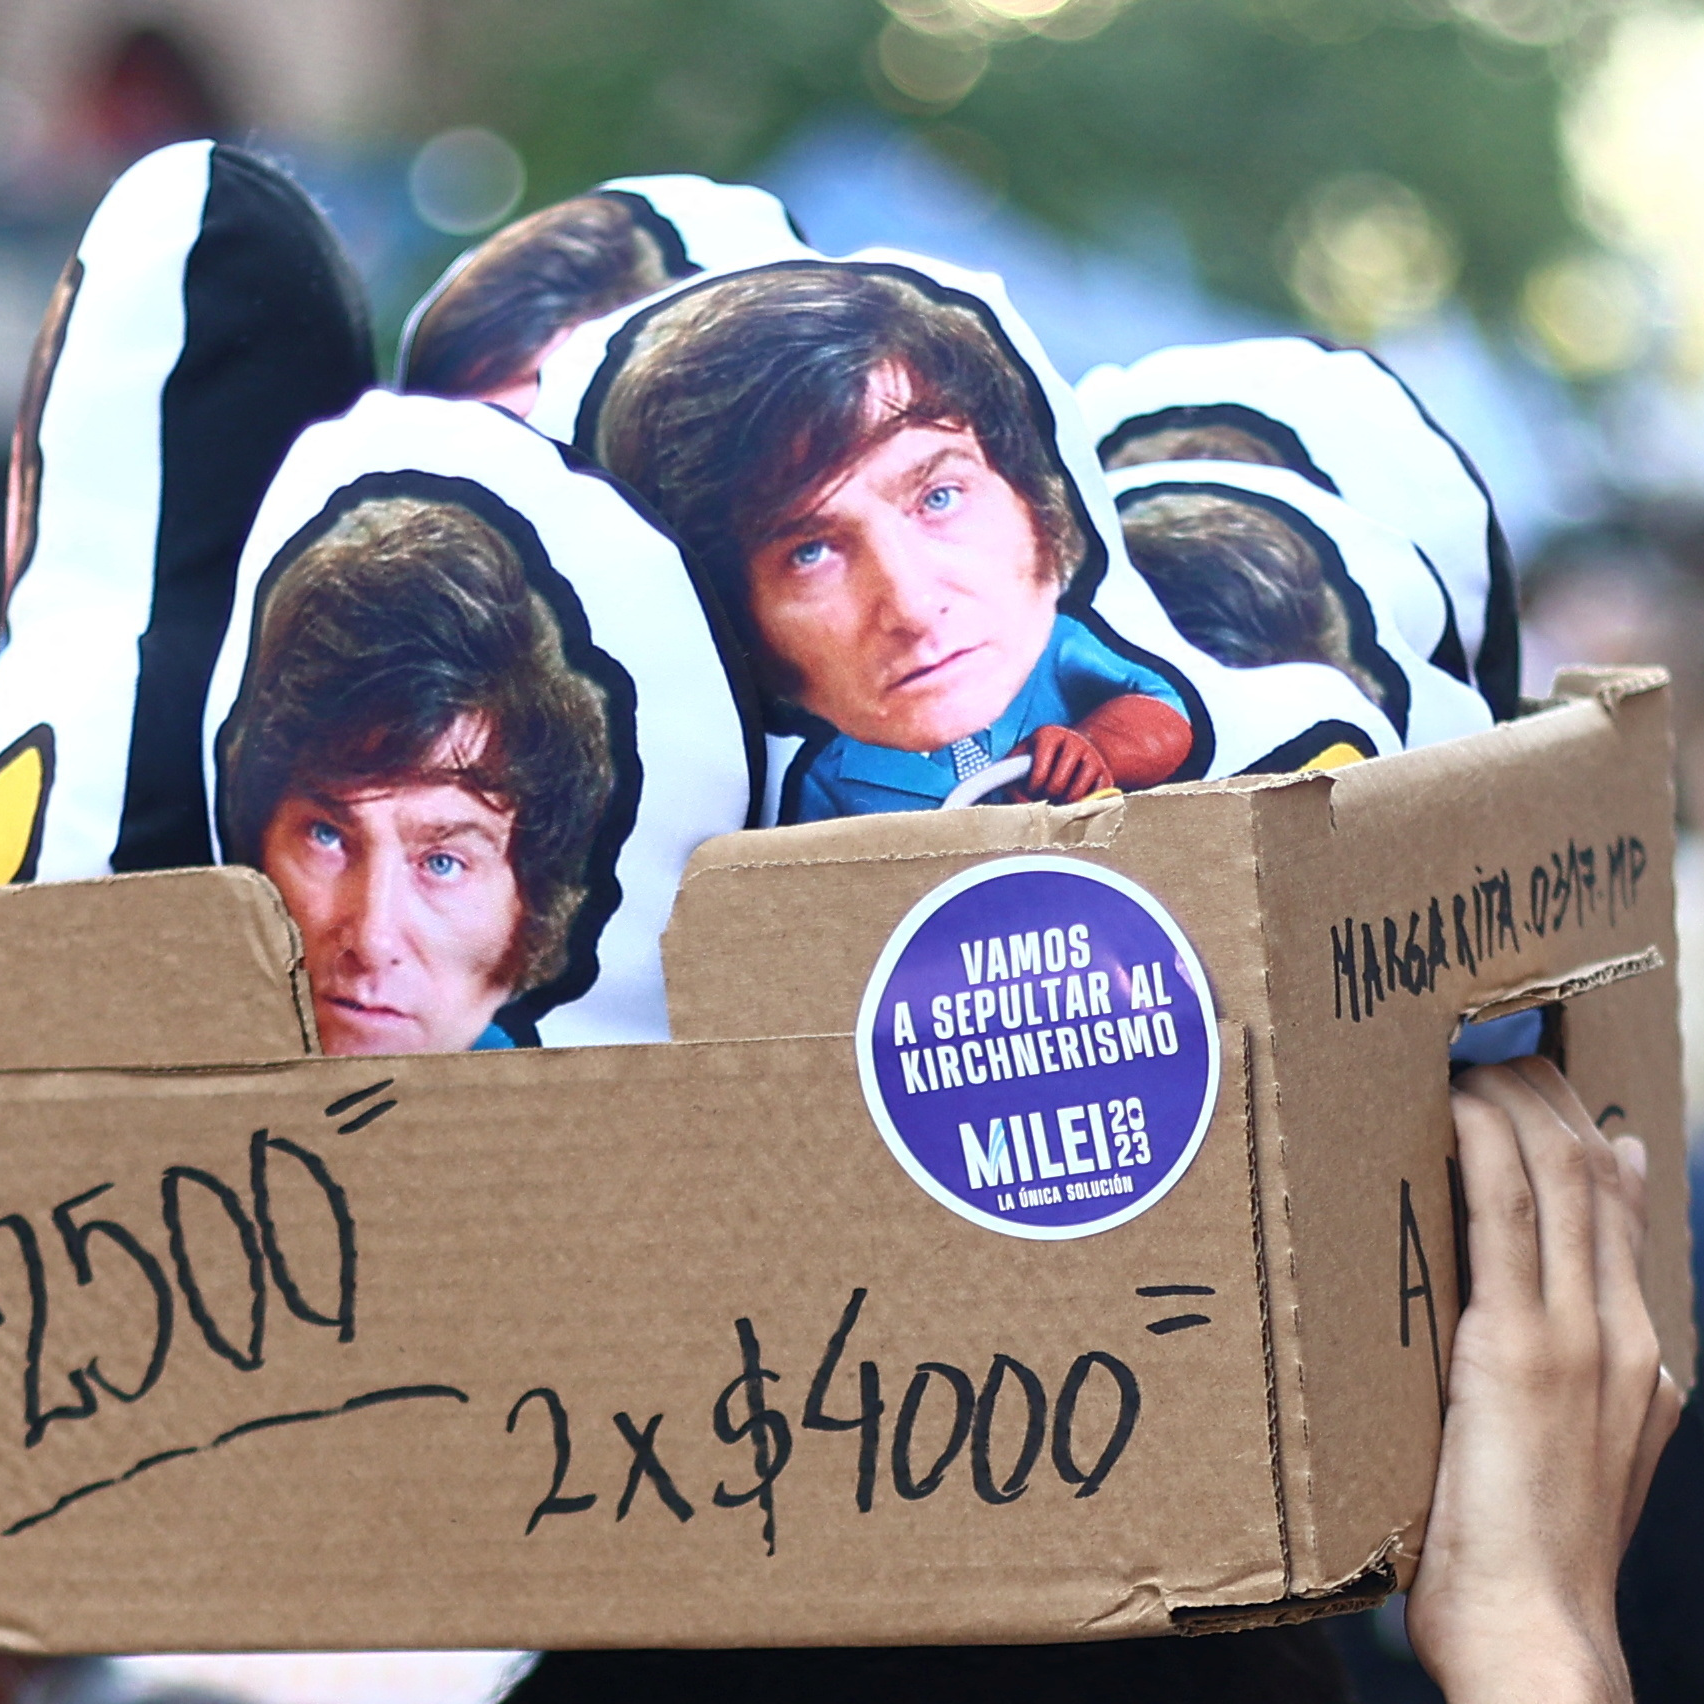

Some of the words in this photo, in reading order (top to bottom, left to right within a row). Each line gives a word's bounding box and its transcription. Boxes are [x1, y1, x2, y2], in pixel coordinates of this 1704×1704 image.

[960, 923, 1091, 986] VAMOS
[894, 1001, 917, 1047] A
[931, 970, 1112, 1040] SEPULTAR
[1130, 961, 1172, 1009] AL
[899, 1011, 1179, 1095] KIRCHNERISMO
[958, 1103, 1112, 1190] MILEI
[997, 1193, 1016, 1212] LA
[1018, 1186, 1063, 1208] ÚNICA
[1065, 1172, 1134, 1201] SOLUCIÓN
